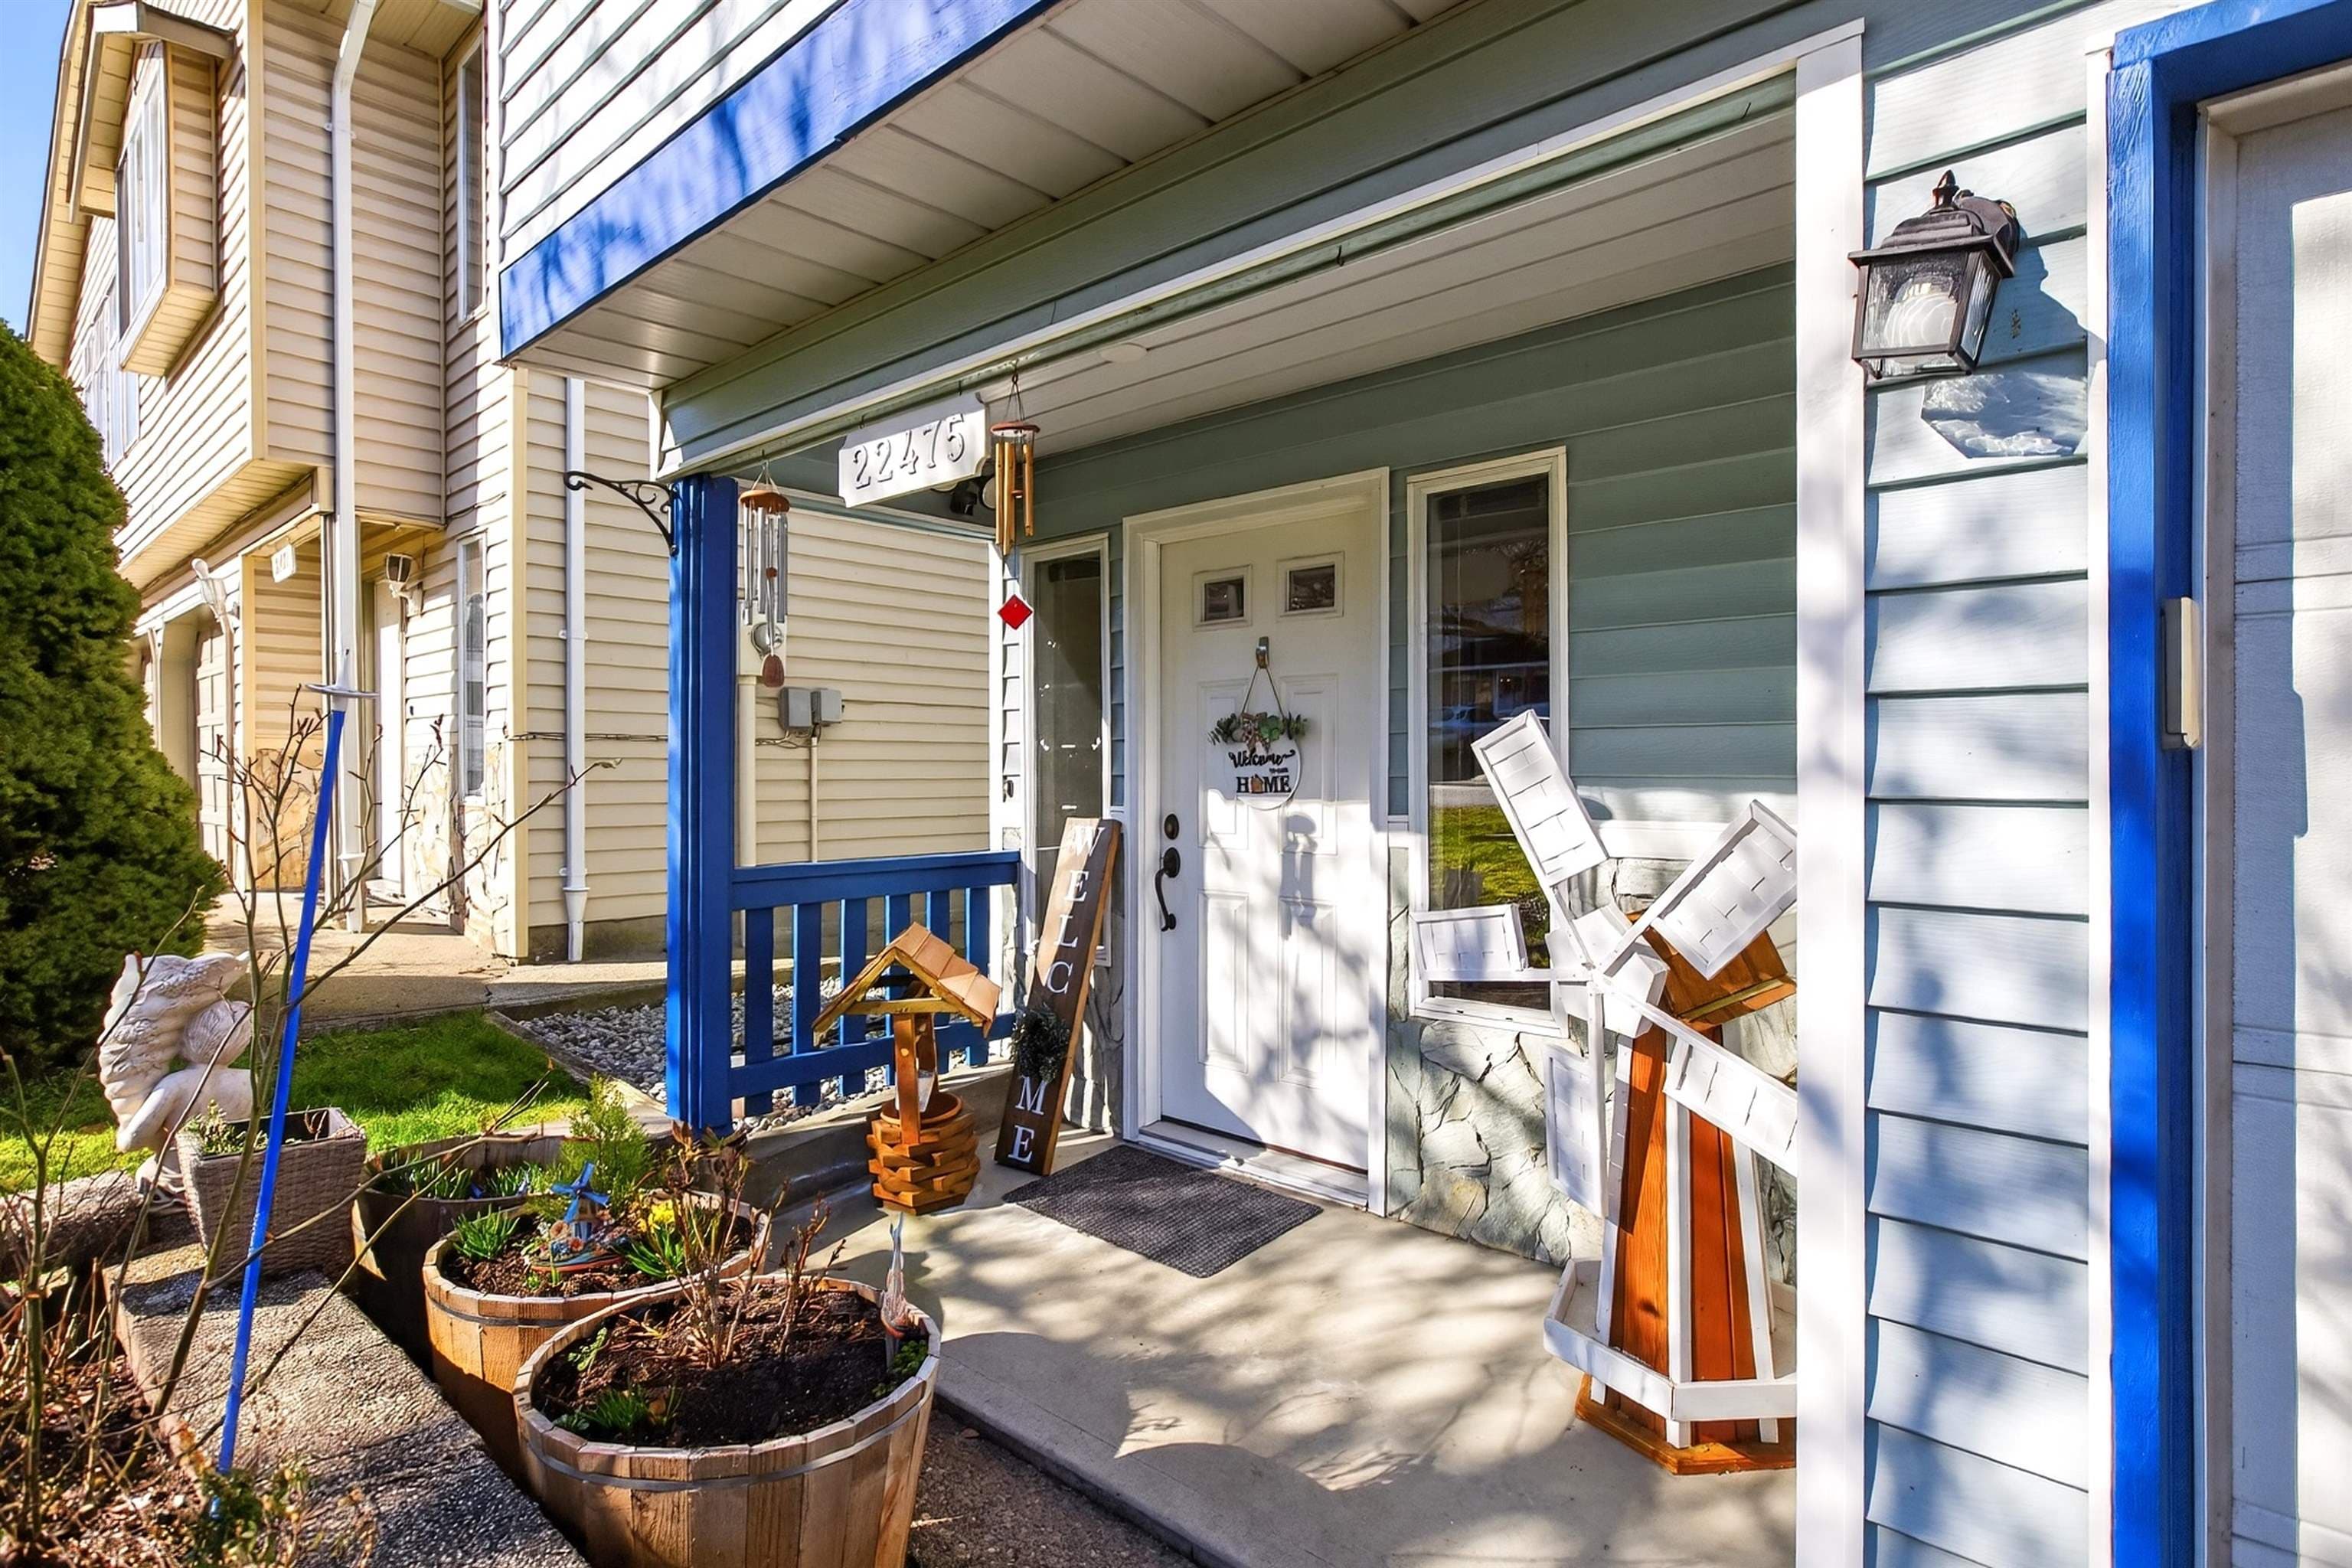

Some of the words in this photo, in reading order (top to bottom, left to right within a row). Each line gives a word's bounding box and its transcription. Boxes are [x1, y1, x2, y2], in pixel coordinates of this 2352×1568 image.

[853, 413, 965, 489] 22475
[1228, 749, 1295, 768] Welcome
[1236, 774, 1291, 793] HME
[1008, 826, 1106, 1162] WELCME
